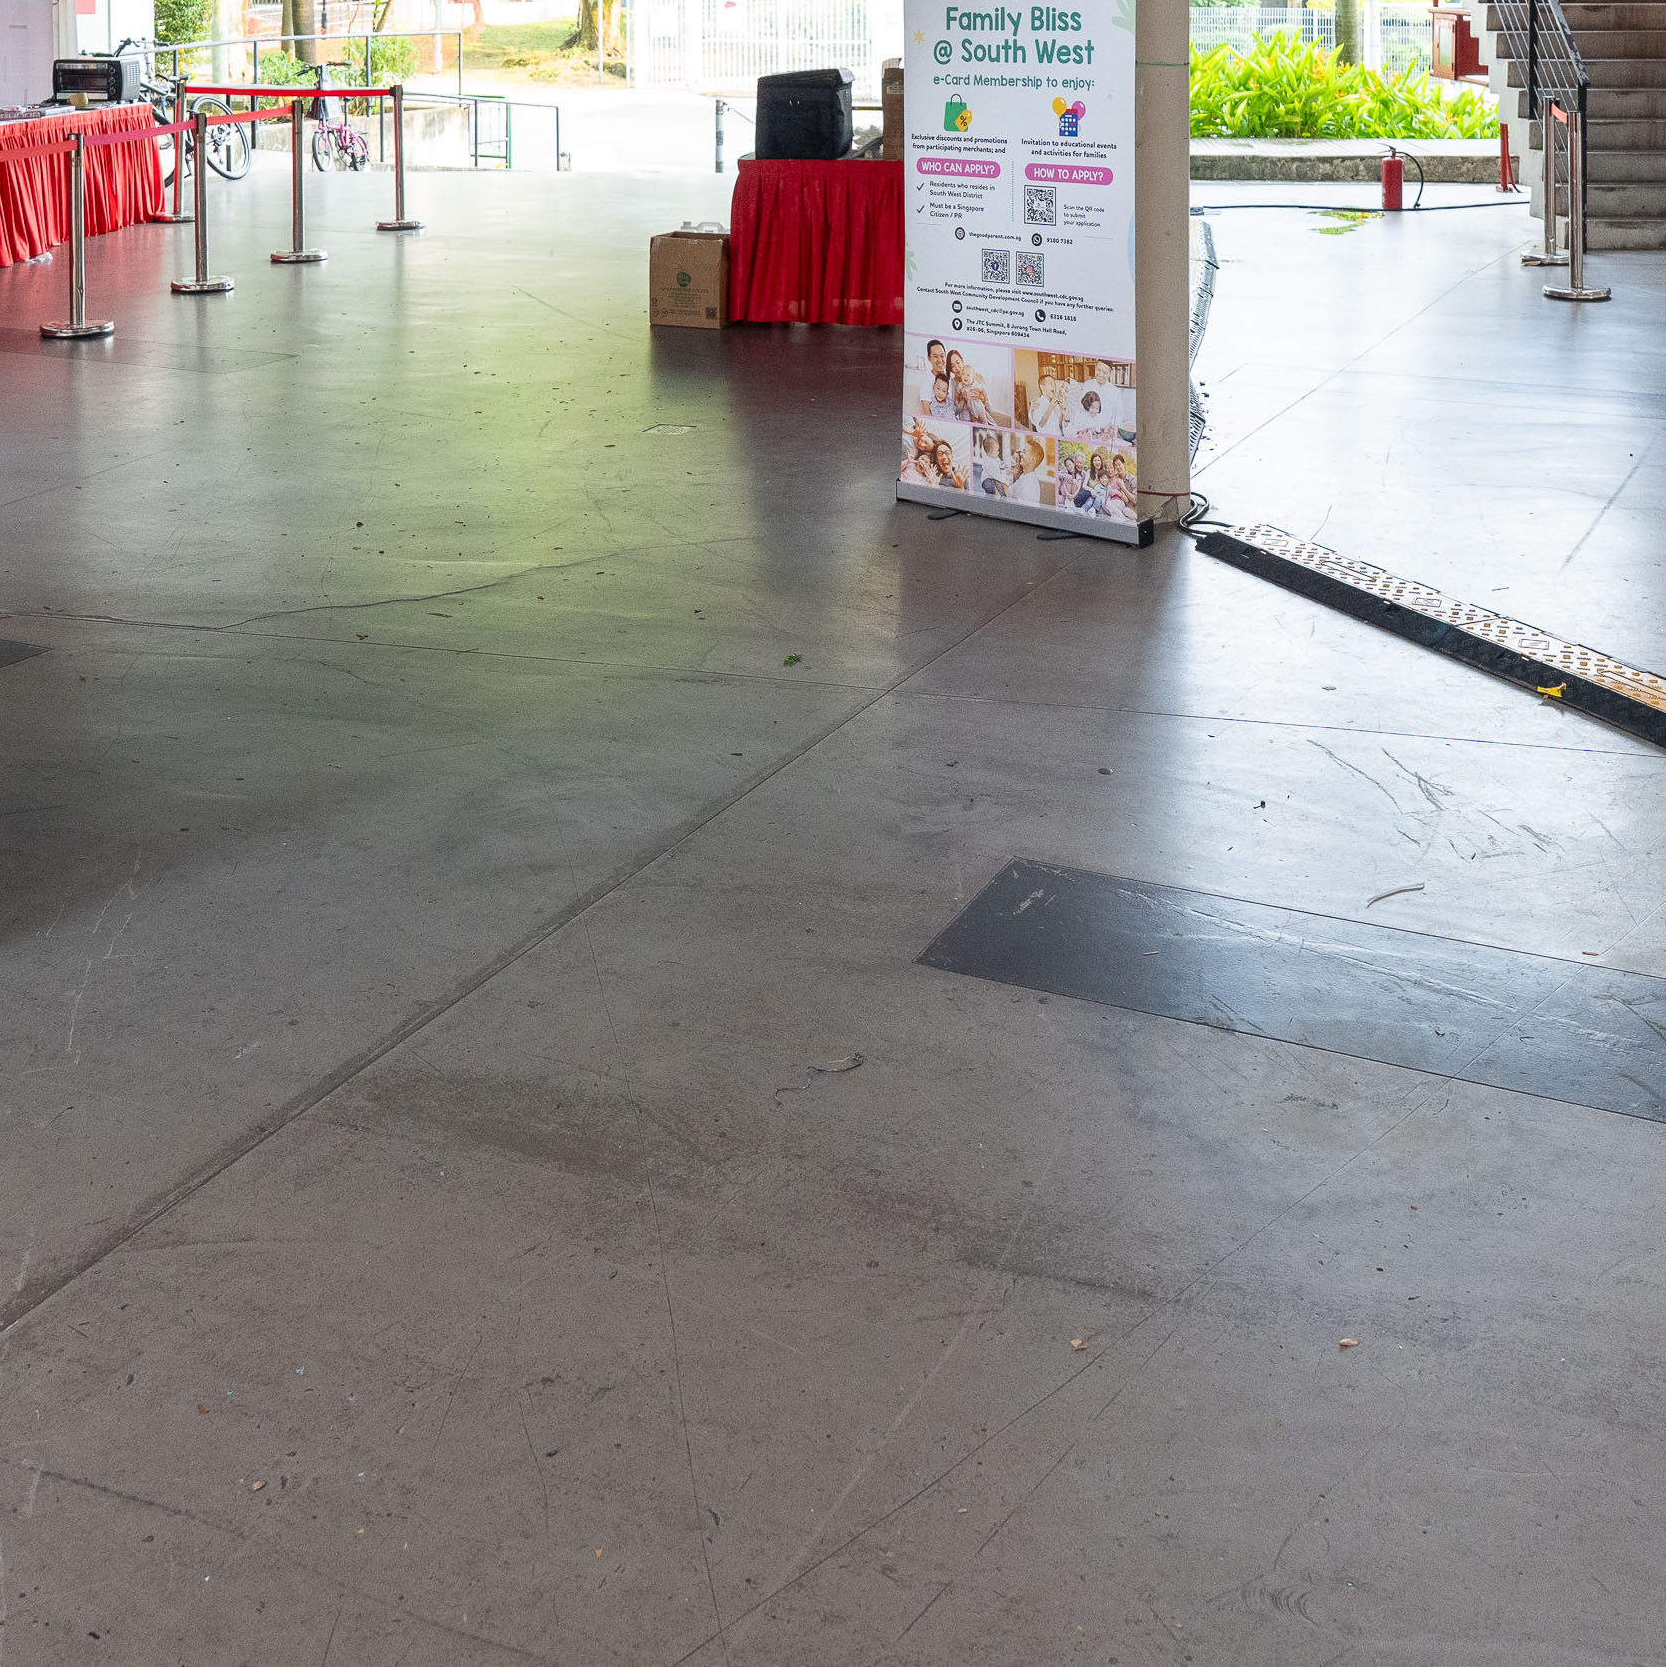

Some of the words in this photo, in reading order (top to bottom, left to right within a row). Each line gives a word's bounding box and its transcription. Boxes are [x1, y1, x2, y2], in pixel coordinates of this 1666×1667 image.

[946, 7, 1022, 36] Family
[1031, 6, 1082, 31] Bliss
[933, 40, 952, 65] @
[961, 38, 1027, 63] South
[1035, 39, 1094, 64] West
[933, 74, 970, 86] e-Card
[974, 75, 1042, 90] Membership
[1046, 77, 1057, 88] to
[1062, 77, 1095, 91] enjoy:
[911, 134, 935, 142] Exclusive
[936, 135, 962, 143] discounts
[1060, 140, 1095, 149] educational
[926, 144, 962, 153] participating
[1083, 151, 1107, 159] families
[921, 161, 941, 172] WHO
[944, 162, 962, 173] CAN
[964, 163, 995, 175] APPLY?
[1034, 168, 1055, 179] HOW
[1058, 169, 1069, 179] TO
[1072, 170, 1103, 181] APPLY?
